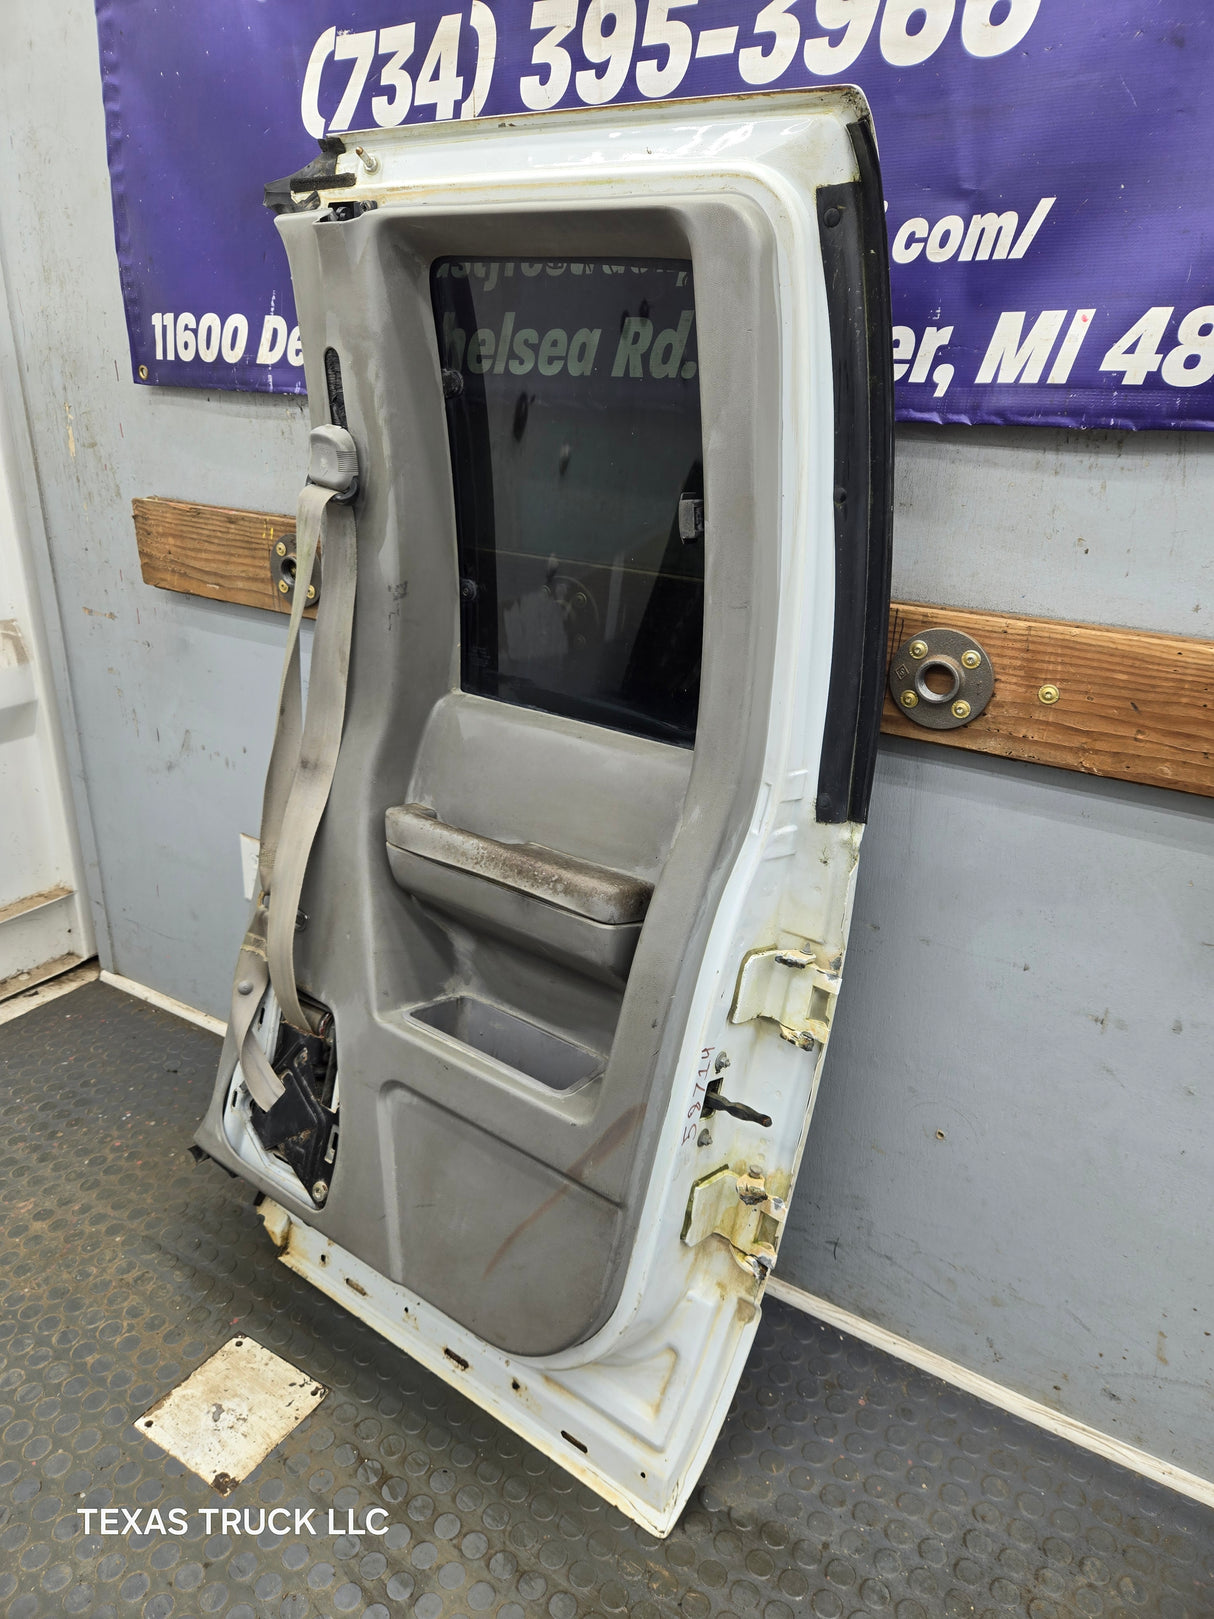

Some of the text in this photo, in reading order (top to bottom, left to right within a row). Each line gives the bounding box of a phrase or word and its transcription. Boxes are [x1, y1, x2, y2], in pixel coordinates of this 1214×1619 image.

[301, 0, 497, 139] (734)
[151, 312, 249, 364] 11600
[611, 309, 697, 380] Rd.
[974, 309, 1097, 385] MI
[681, 1046, 716, 1147] 58714
